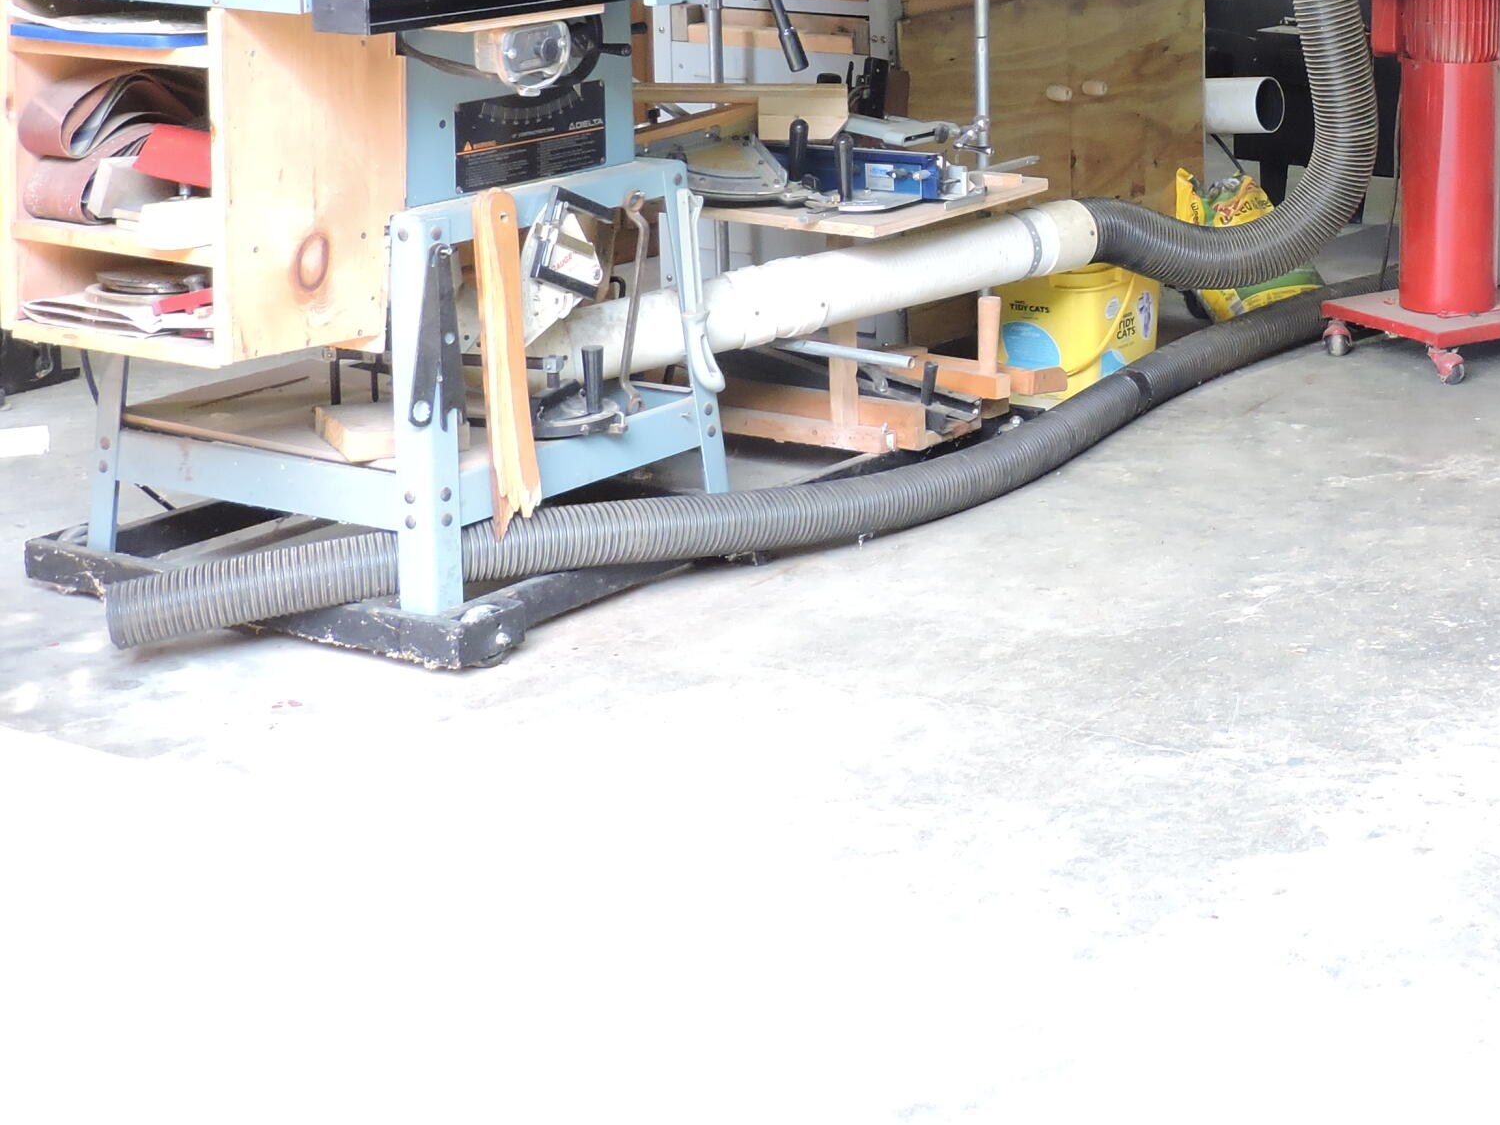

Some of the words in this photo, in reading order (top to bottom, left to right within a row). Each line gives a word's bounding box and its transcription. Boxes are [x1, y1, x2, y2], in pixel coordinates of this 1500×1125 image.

[1009, 303, 1028, 312] TIDY
[1028, 304, 1050, 314] CATS
[1118, 317, 1135, 331] TIDY
[1116, 326, 1136, 340] CATS
